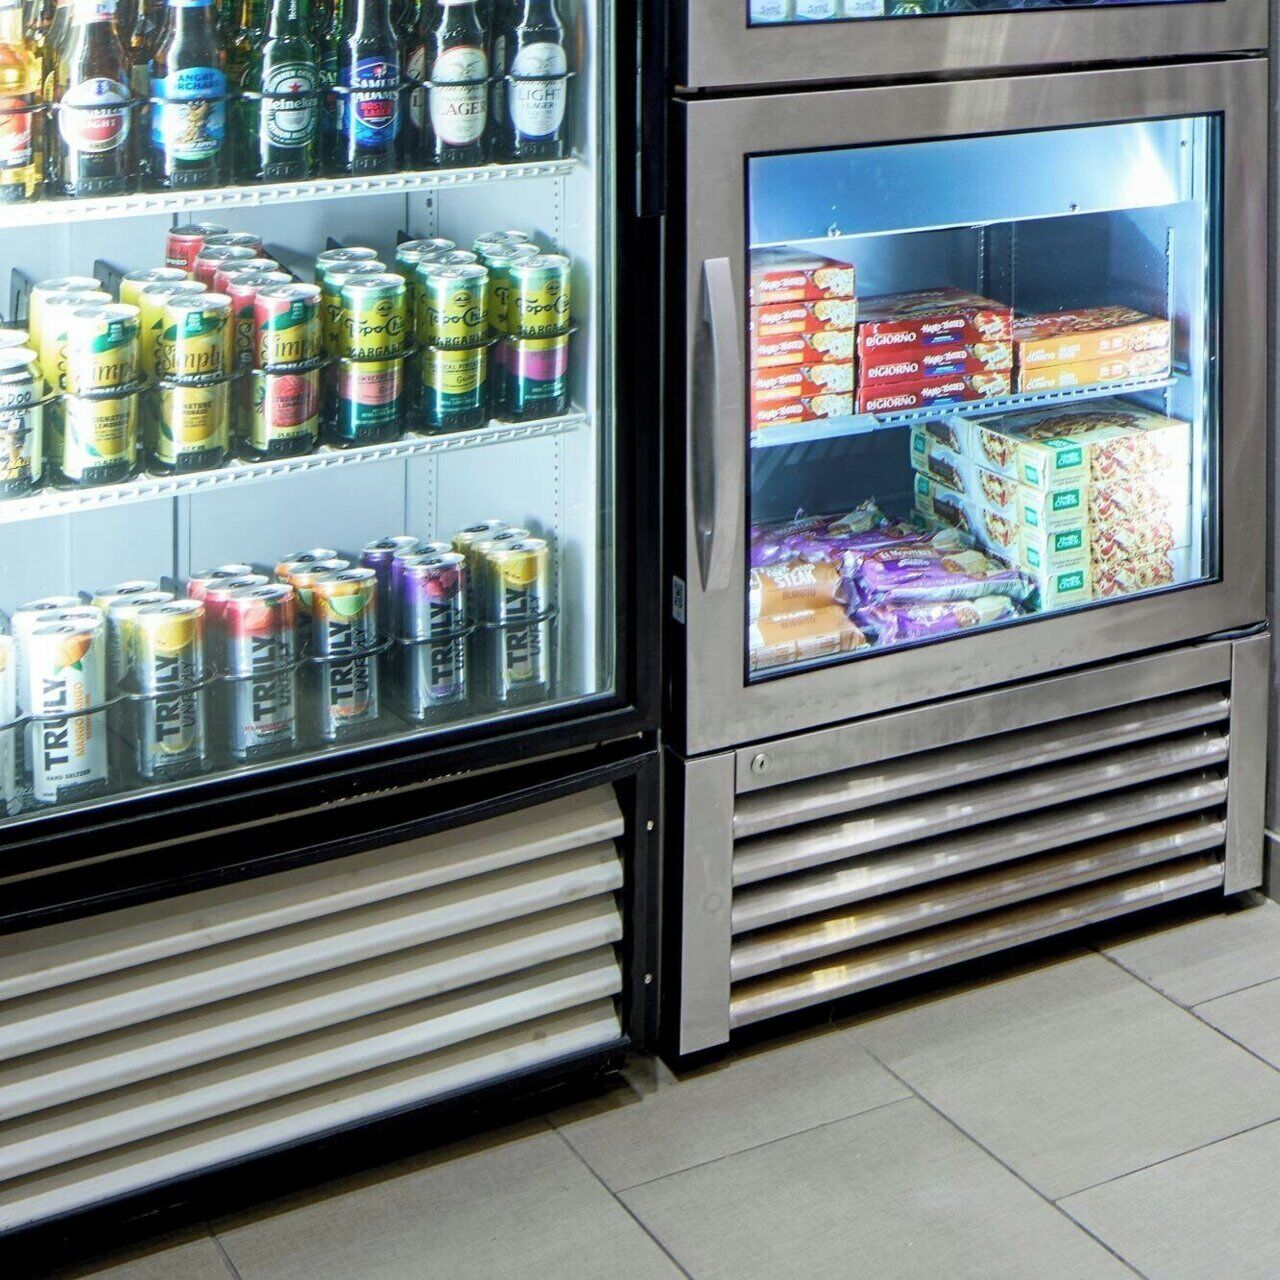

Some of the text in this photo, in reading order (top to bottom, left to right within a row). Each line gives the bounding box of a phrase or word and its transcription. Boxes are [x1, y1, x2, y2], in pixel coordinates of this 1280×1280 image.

[361, 90, 399, 102] ADAMS
[864, 332, 918, 348] DIGIORNO
[866, 362, 920, 379] DIGIORNO
[866, 394, 918, 413] DIGIORNO
[778, 564, 819, 590] STEAK
[783, 587, 818, 602] BURRITO
[430, 601, 454, 688] TRULY
[505, 586, 529, 677] TRULY
[251, 635, 281, 723] TRULY
[329, 620, 354, 706] TRULY
[43, 677, 71, 773] TRULY
[154, 655, 183, 745] TRULY
